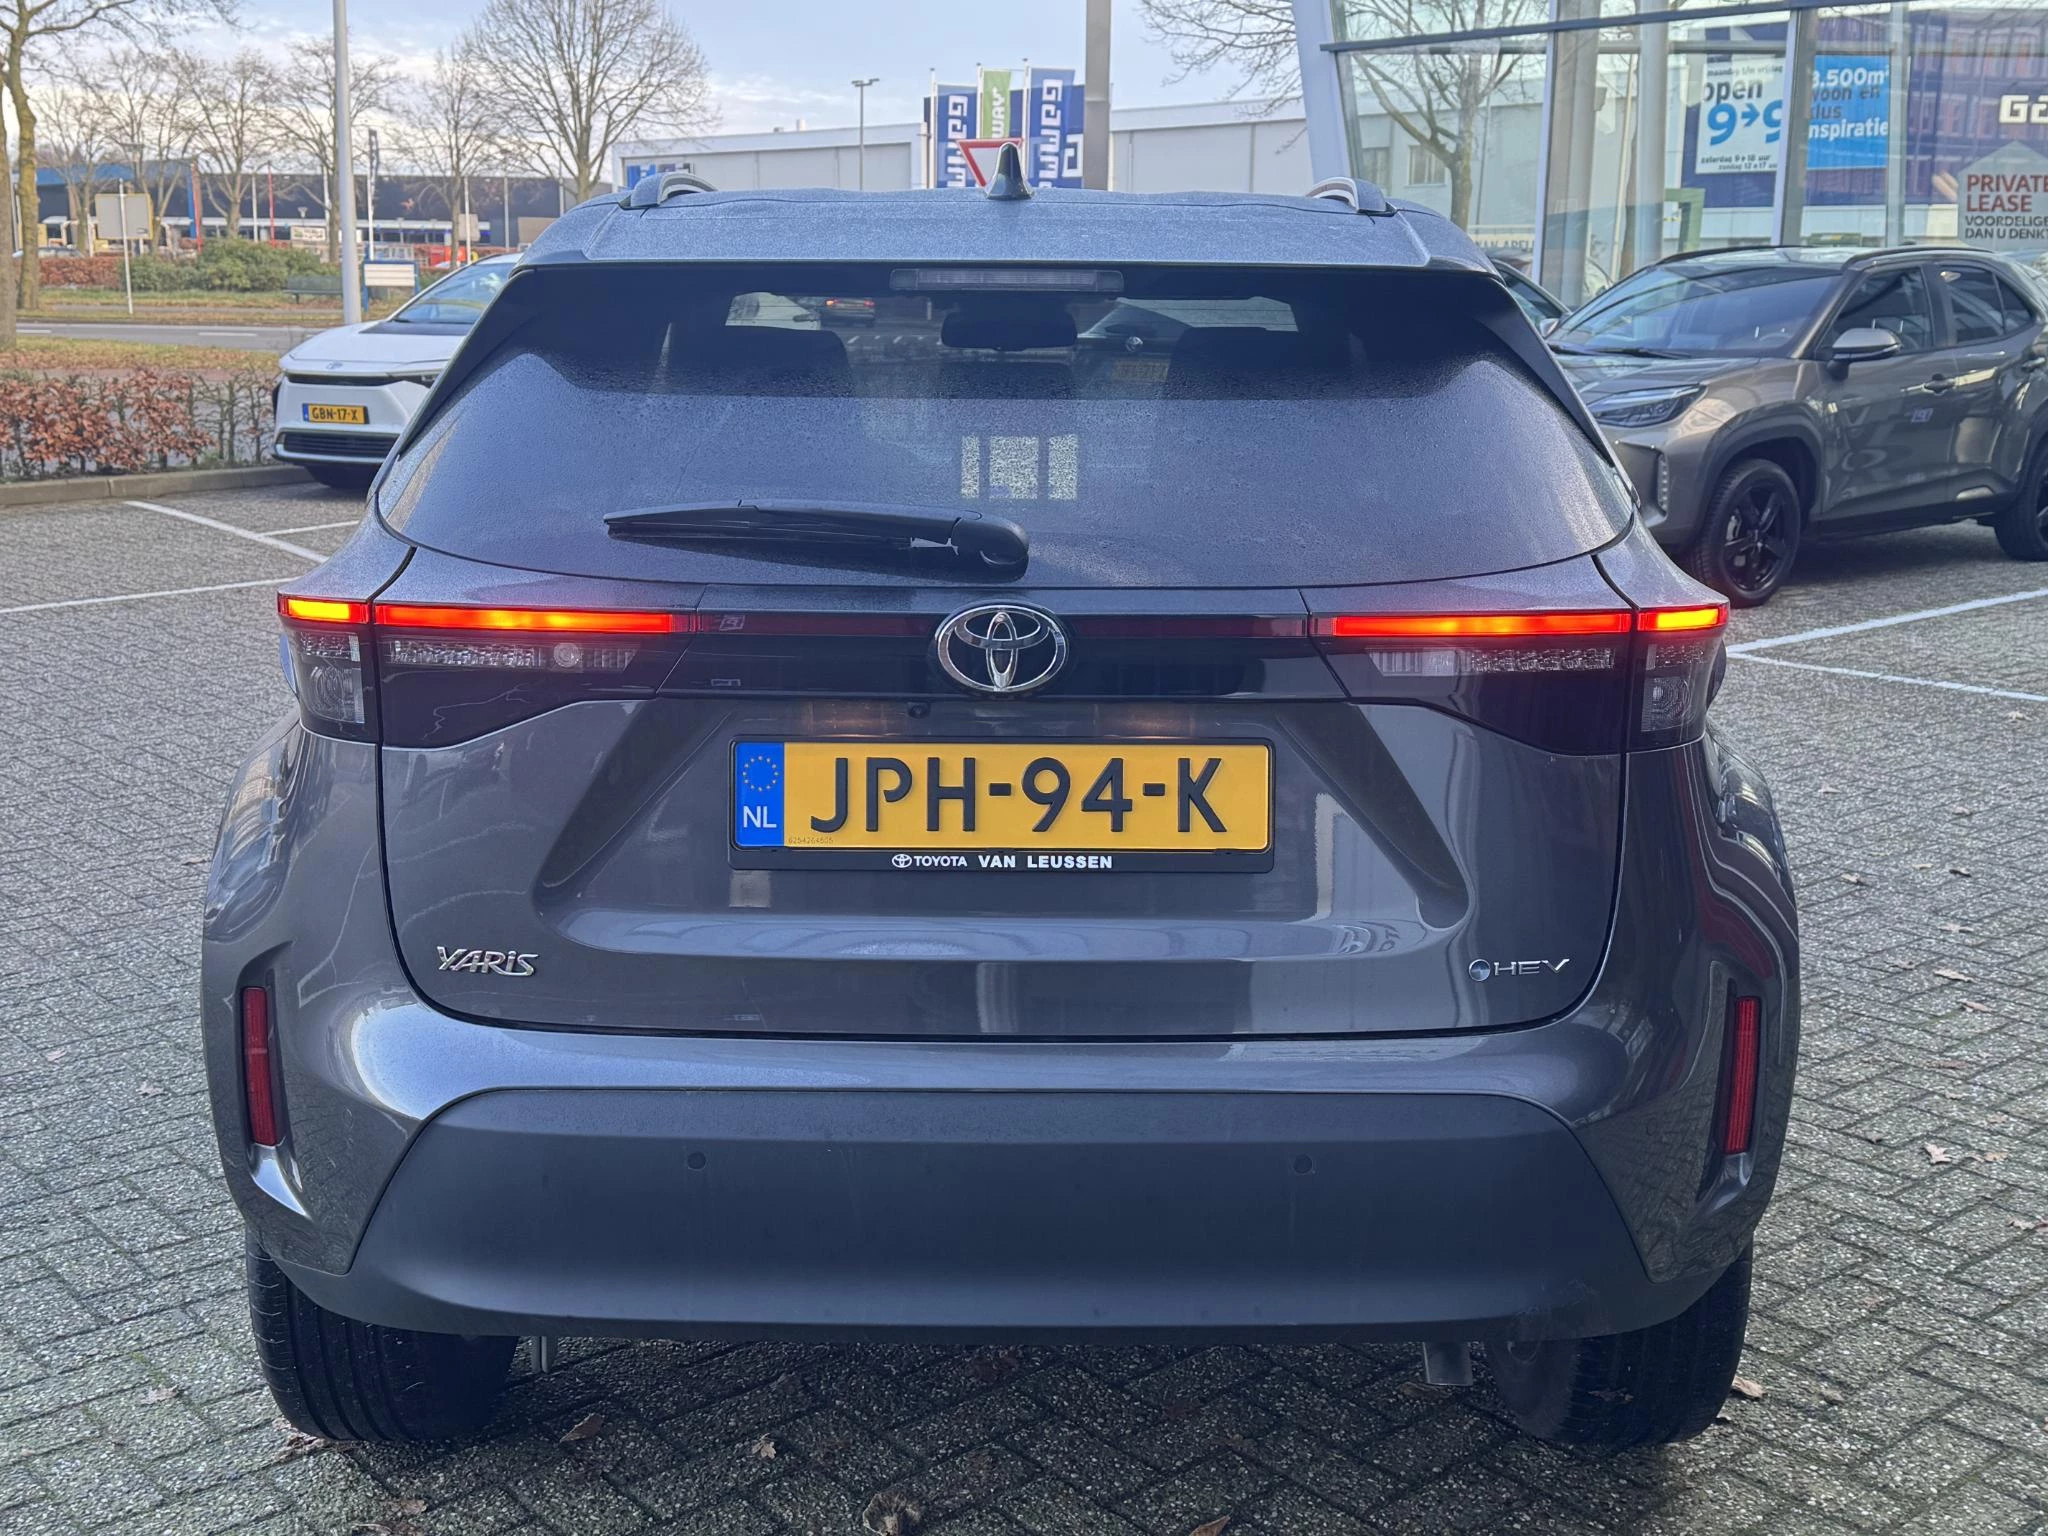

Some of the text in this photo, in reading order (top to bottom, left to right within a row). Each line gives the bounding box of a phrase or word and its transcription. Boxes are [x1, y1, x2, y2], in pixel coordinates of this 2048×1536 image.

[1704, 80, 1763, 105] open
[1811, 104, 1841, 119] lus
[1967, 194, 2032, 212] LEASE
[1965, 228, 2048, 239] DAN U DENK
[312, 407, 358, 420] GBN-17-X
[743, 757, 1227, 833] NL JPH-94-K
[914, 855, 1112, 868] TOYOTA VAN LEUSSEN
[1494, 958, 1570, 976] HEV
